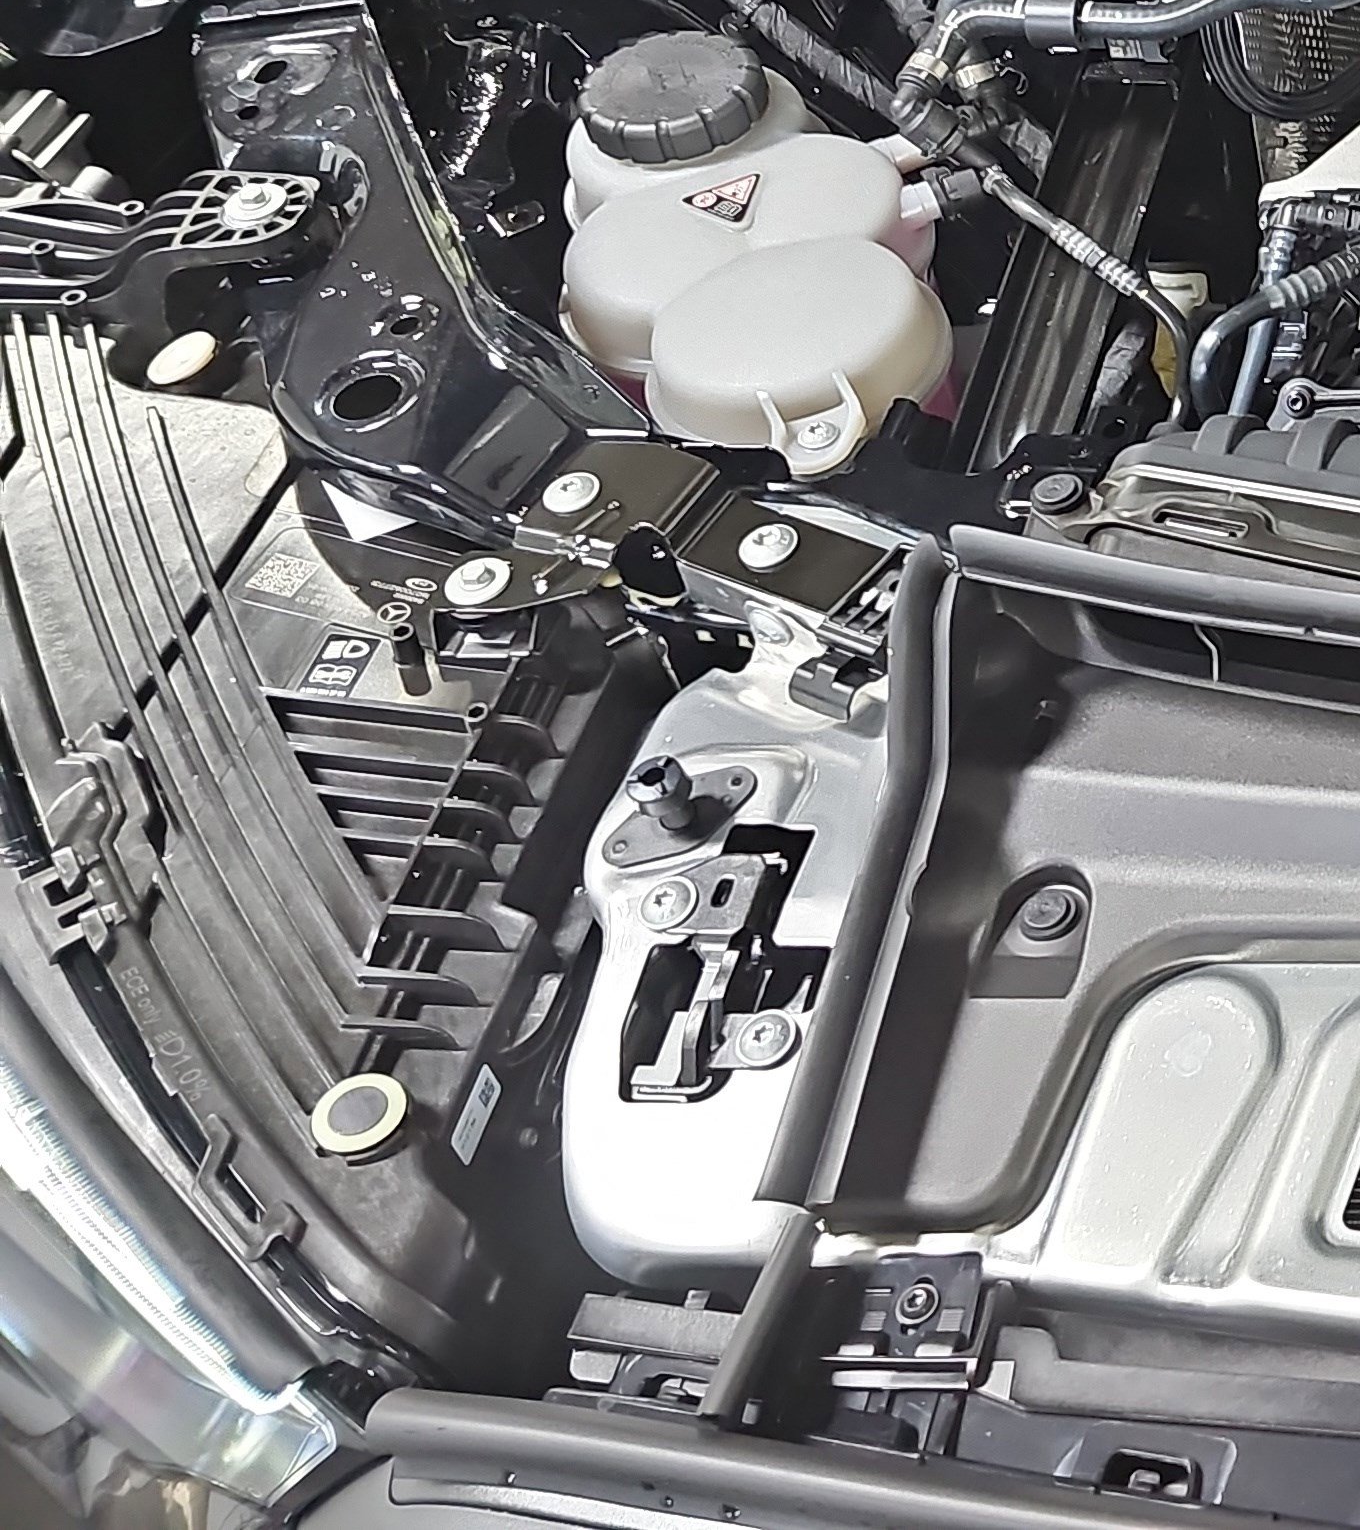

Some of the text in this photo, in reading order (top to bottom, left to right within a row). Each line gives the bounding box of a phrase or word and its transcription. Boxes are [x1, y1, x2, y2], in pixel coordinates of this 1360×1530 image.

[119, 966, 214, 1102] ECE only 1.0%
